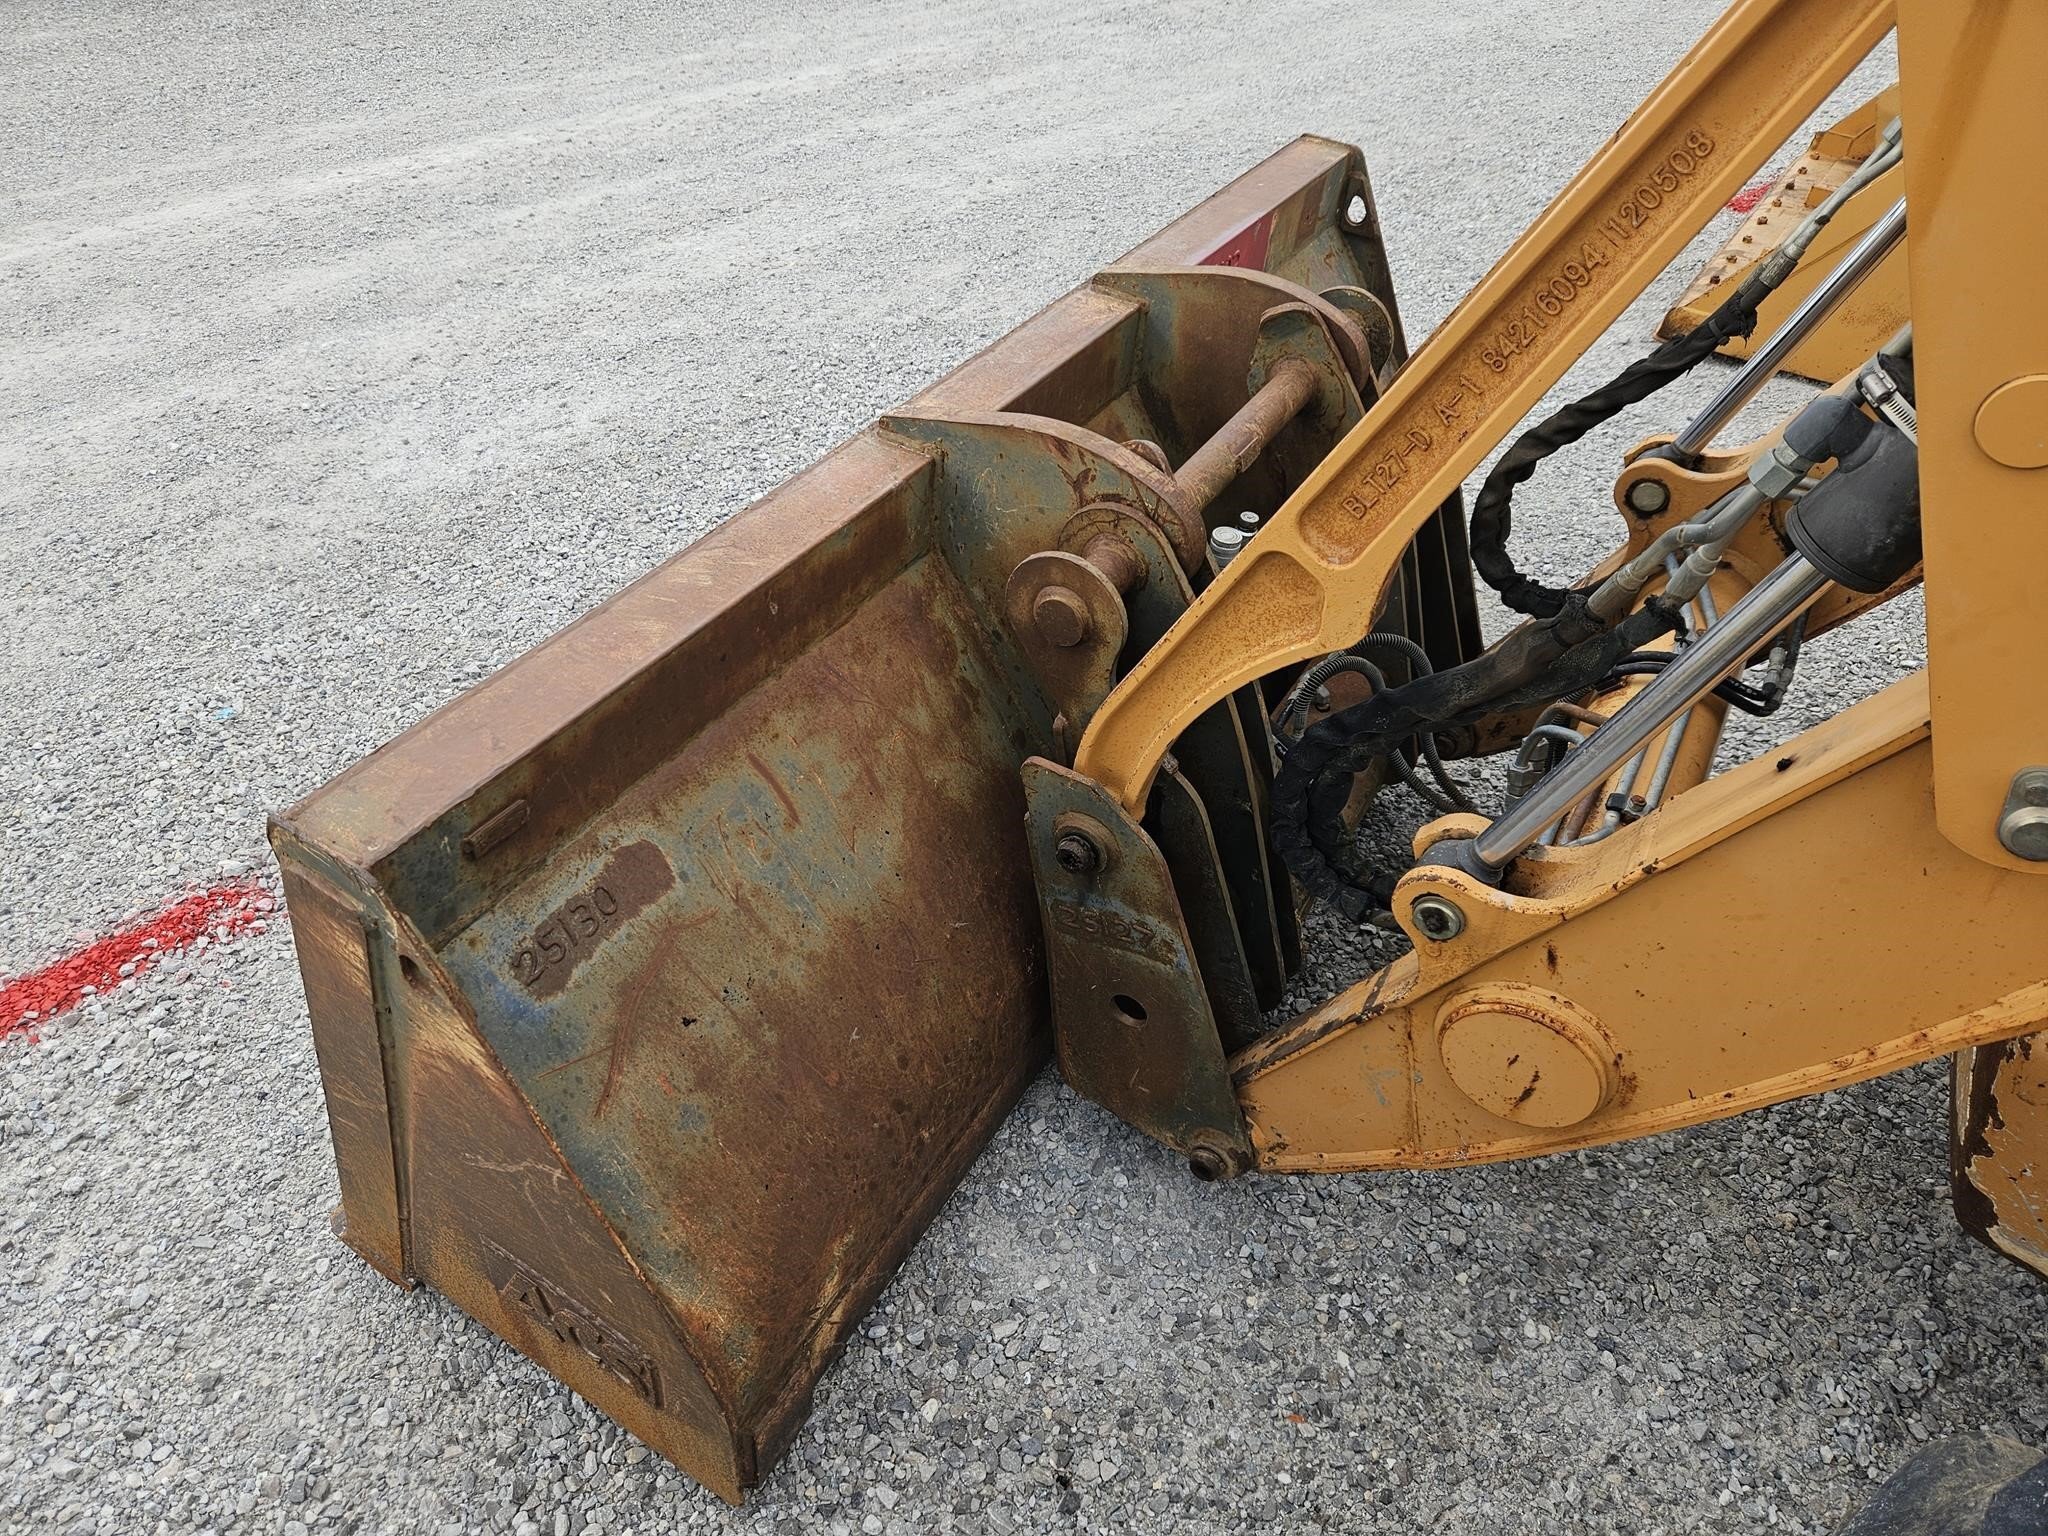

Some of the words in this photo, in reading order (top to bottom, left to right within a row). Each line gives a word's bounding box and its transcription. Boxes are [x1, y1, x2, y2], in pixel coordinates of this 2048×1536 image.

[1342, 427, 1432, 520] BLT27-D
[1433, 375, 1484, 427] A-1
[1481, 242, 1610, 373] 84216094
